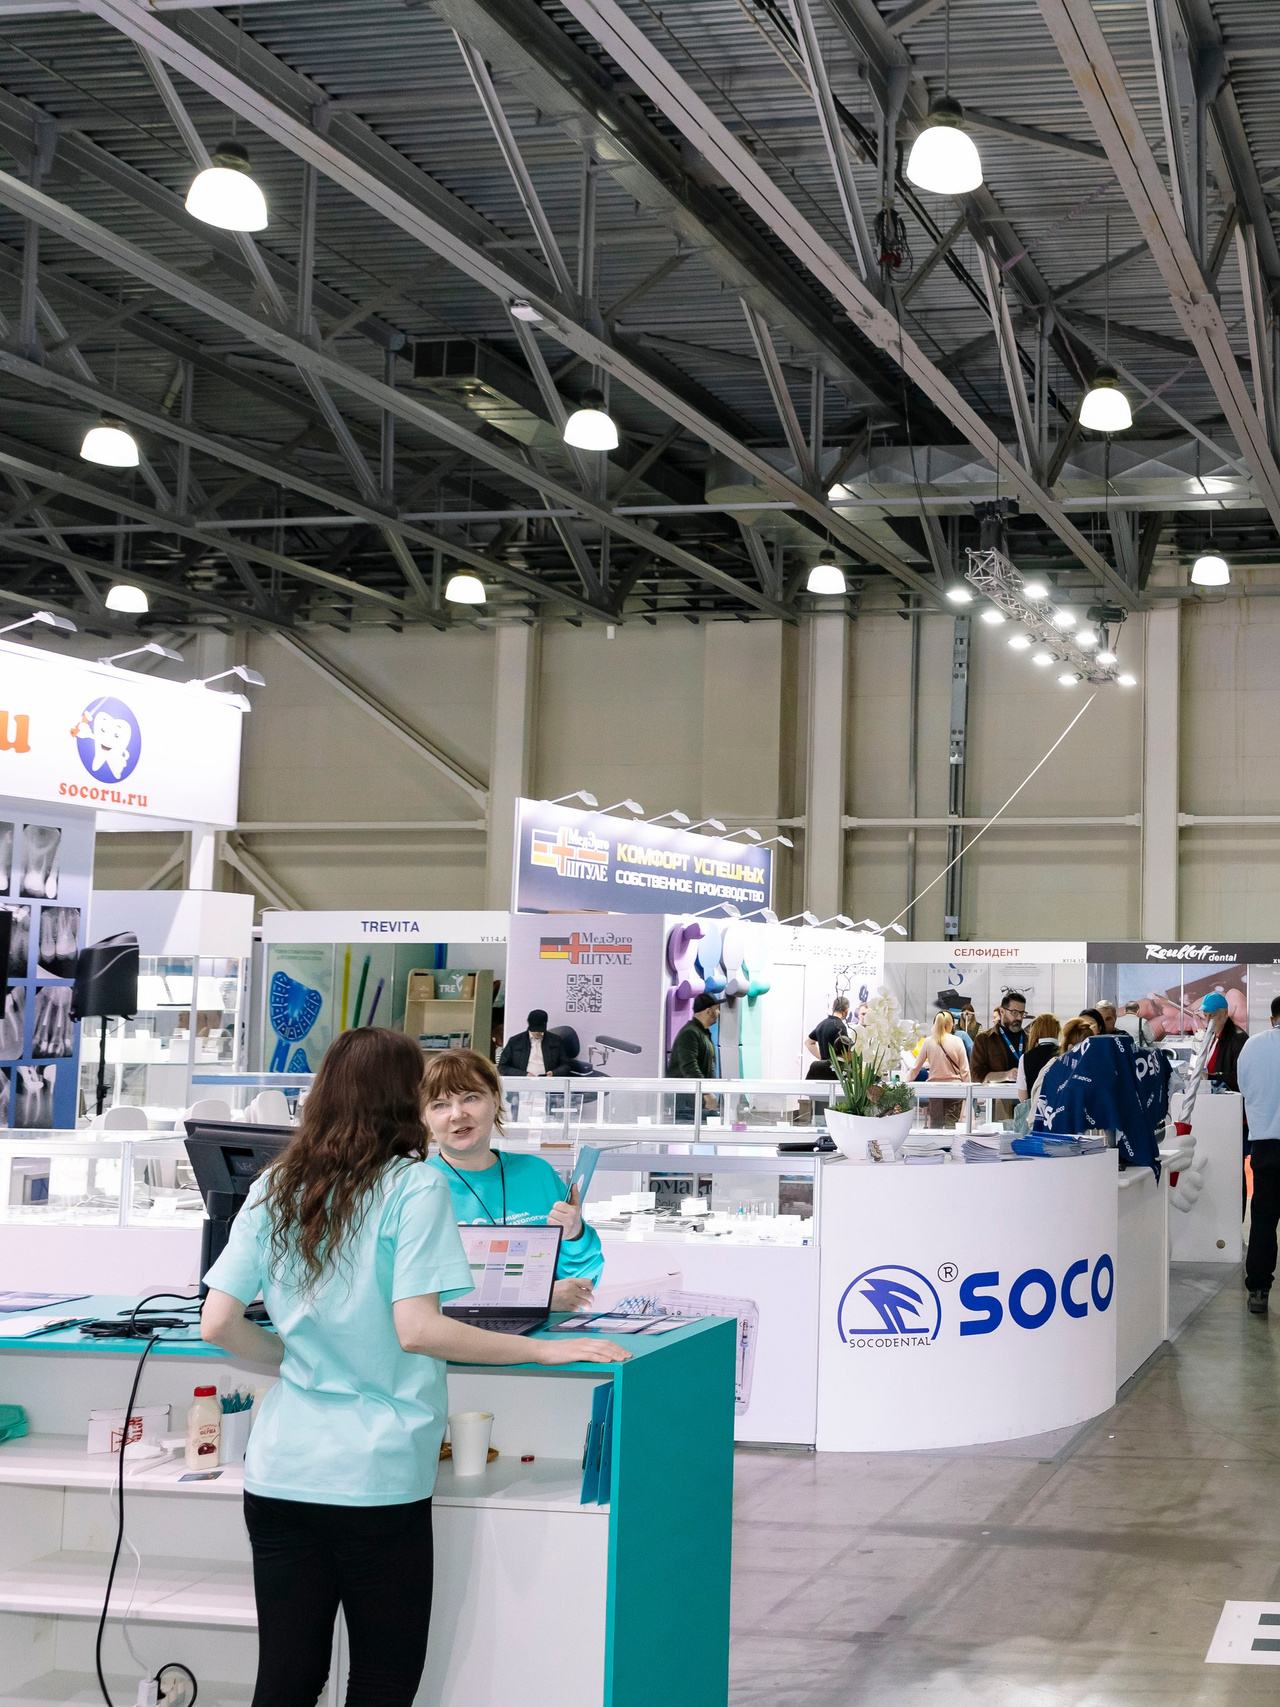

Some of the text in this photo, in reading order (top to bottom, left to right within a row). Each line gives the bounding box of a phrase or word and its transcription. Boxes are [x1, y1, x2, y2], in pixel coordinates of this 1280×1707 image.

[58, 782, 148, 807] socoru.ru
[568, 828, 610, 852] МедЭрго
[566, 861, 609, 882] ШТУЛЕ
[616, 842, 765, 885] КОМФОРТ УСПЕШНЫХ
[615, 869, 764, 903] СОБСТВЕННОЕ ПРОИЗВОДСТВО
[361, 920, 420, 933] TREVITA
[581, 931, 633, 946] МедЭрго
[581, 953, 633, 966] ШТУЛЕ
[954, 948, 1020, 958] СЕЛФИДЕНТ
[1208, 952, 1237, 962] dental
[1123, 1140, 1135, 1157] SOCO
[959, 1253, 1114, 1337] SOCO
[849, 1336, 932, 1349] SOCODENTAL
